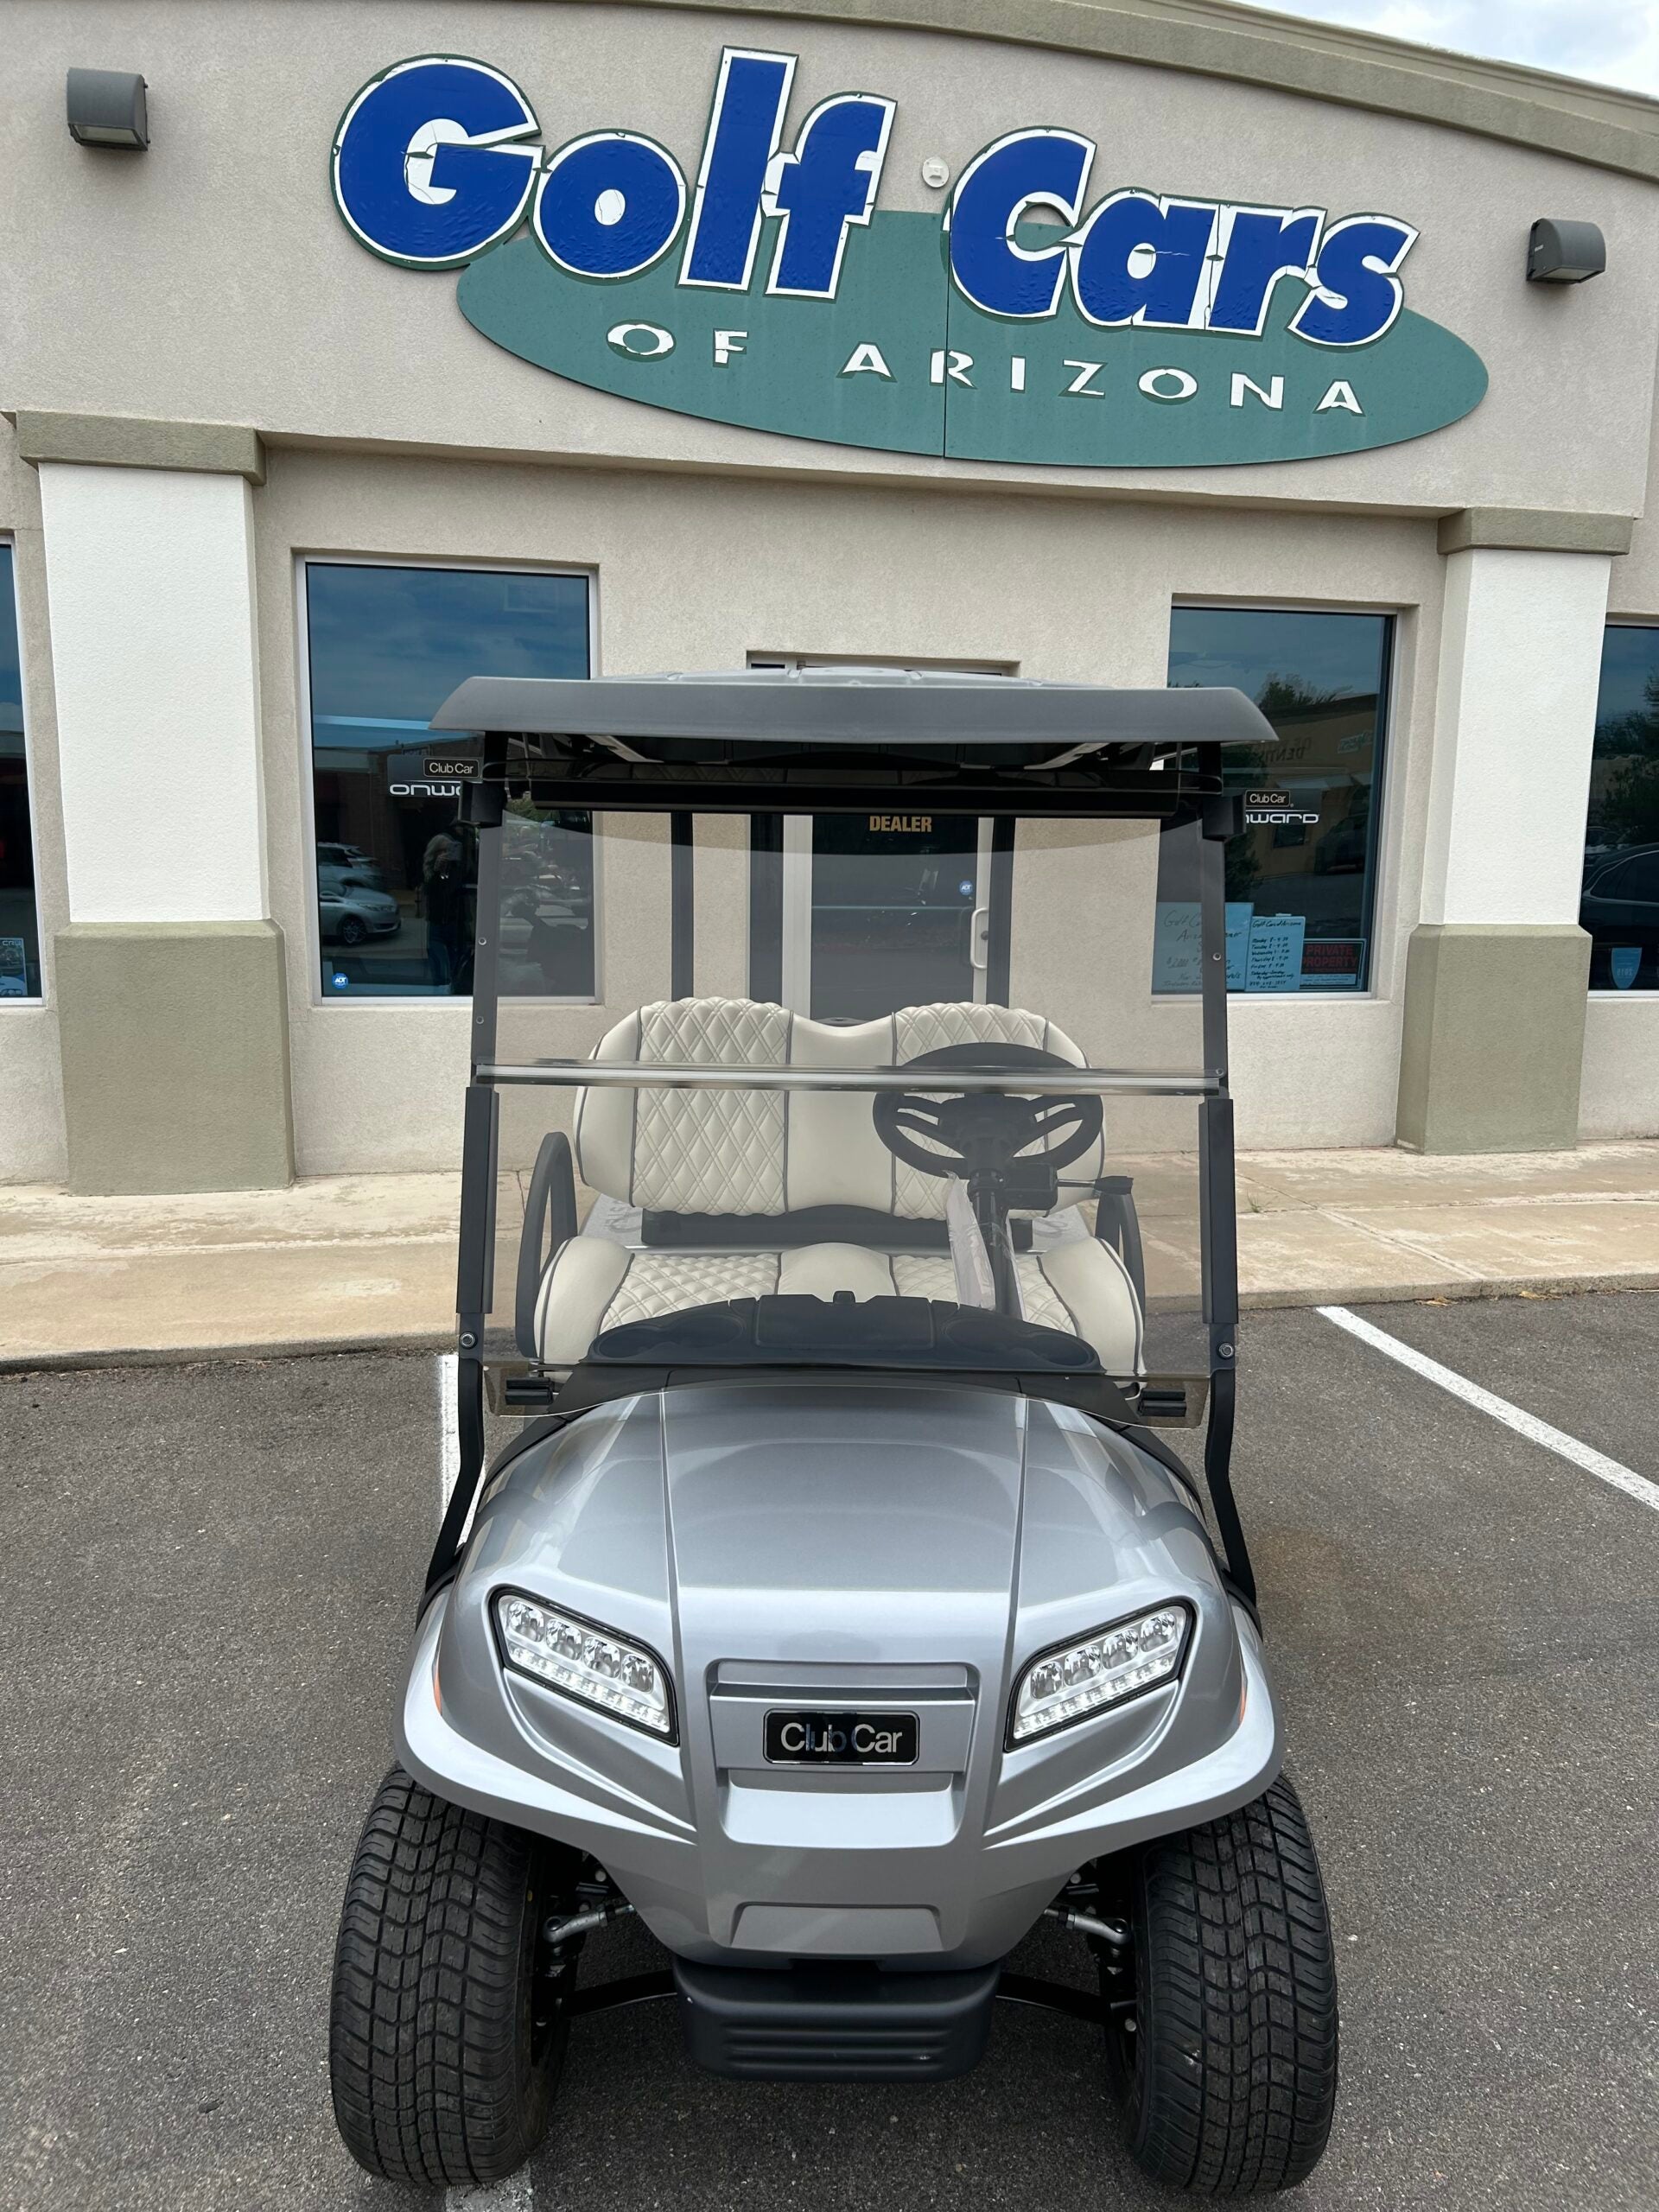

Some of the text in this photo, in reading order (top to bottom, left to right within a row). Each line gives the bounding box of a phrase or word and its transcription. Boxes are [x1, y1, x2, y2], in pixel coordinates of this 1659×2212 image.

[331, 46, 1420, 347] Golf Cars
[607, 322, 1364, 416] OF ARIZONA
[429, 762, 474, 774] Club Car
[389, 784, 461, 796] onw
[1249, 793, 1286, 804] Club Car
[869, 815, 932, 832] DEALER
[1306, 944, 1354, 955] PRIVATE
[780, 1722, 903, 1753] Club Car
